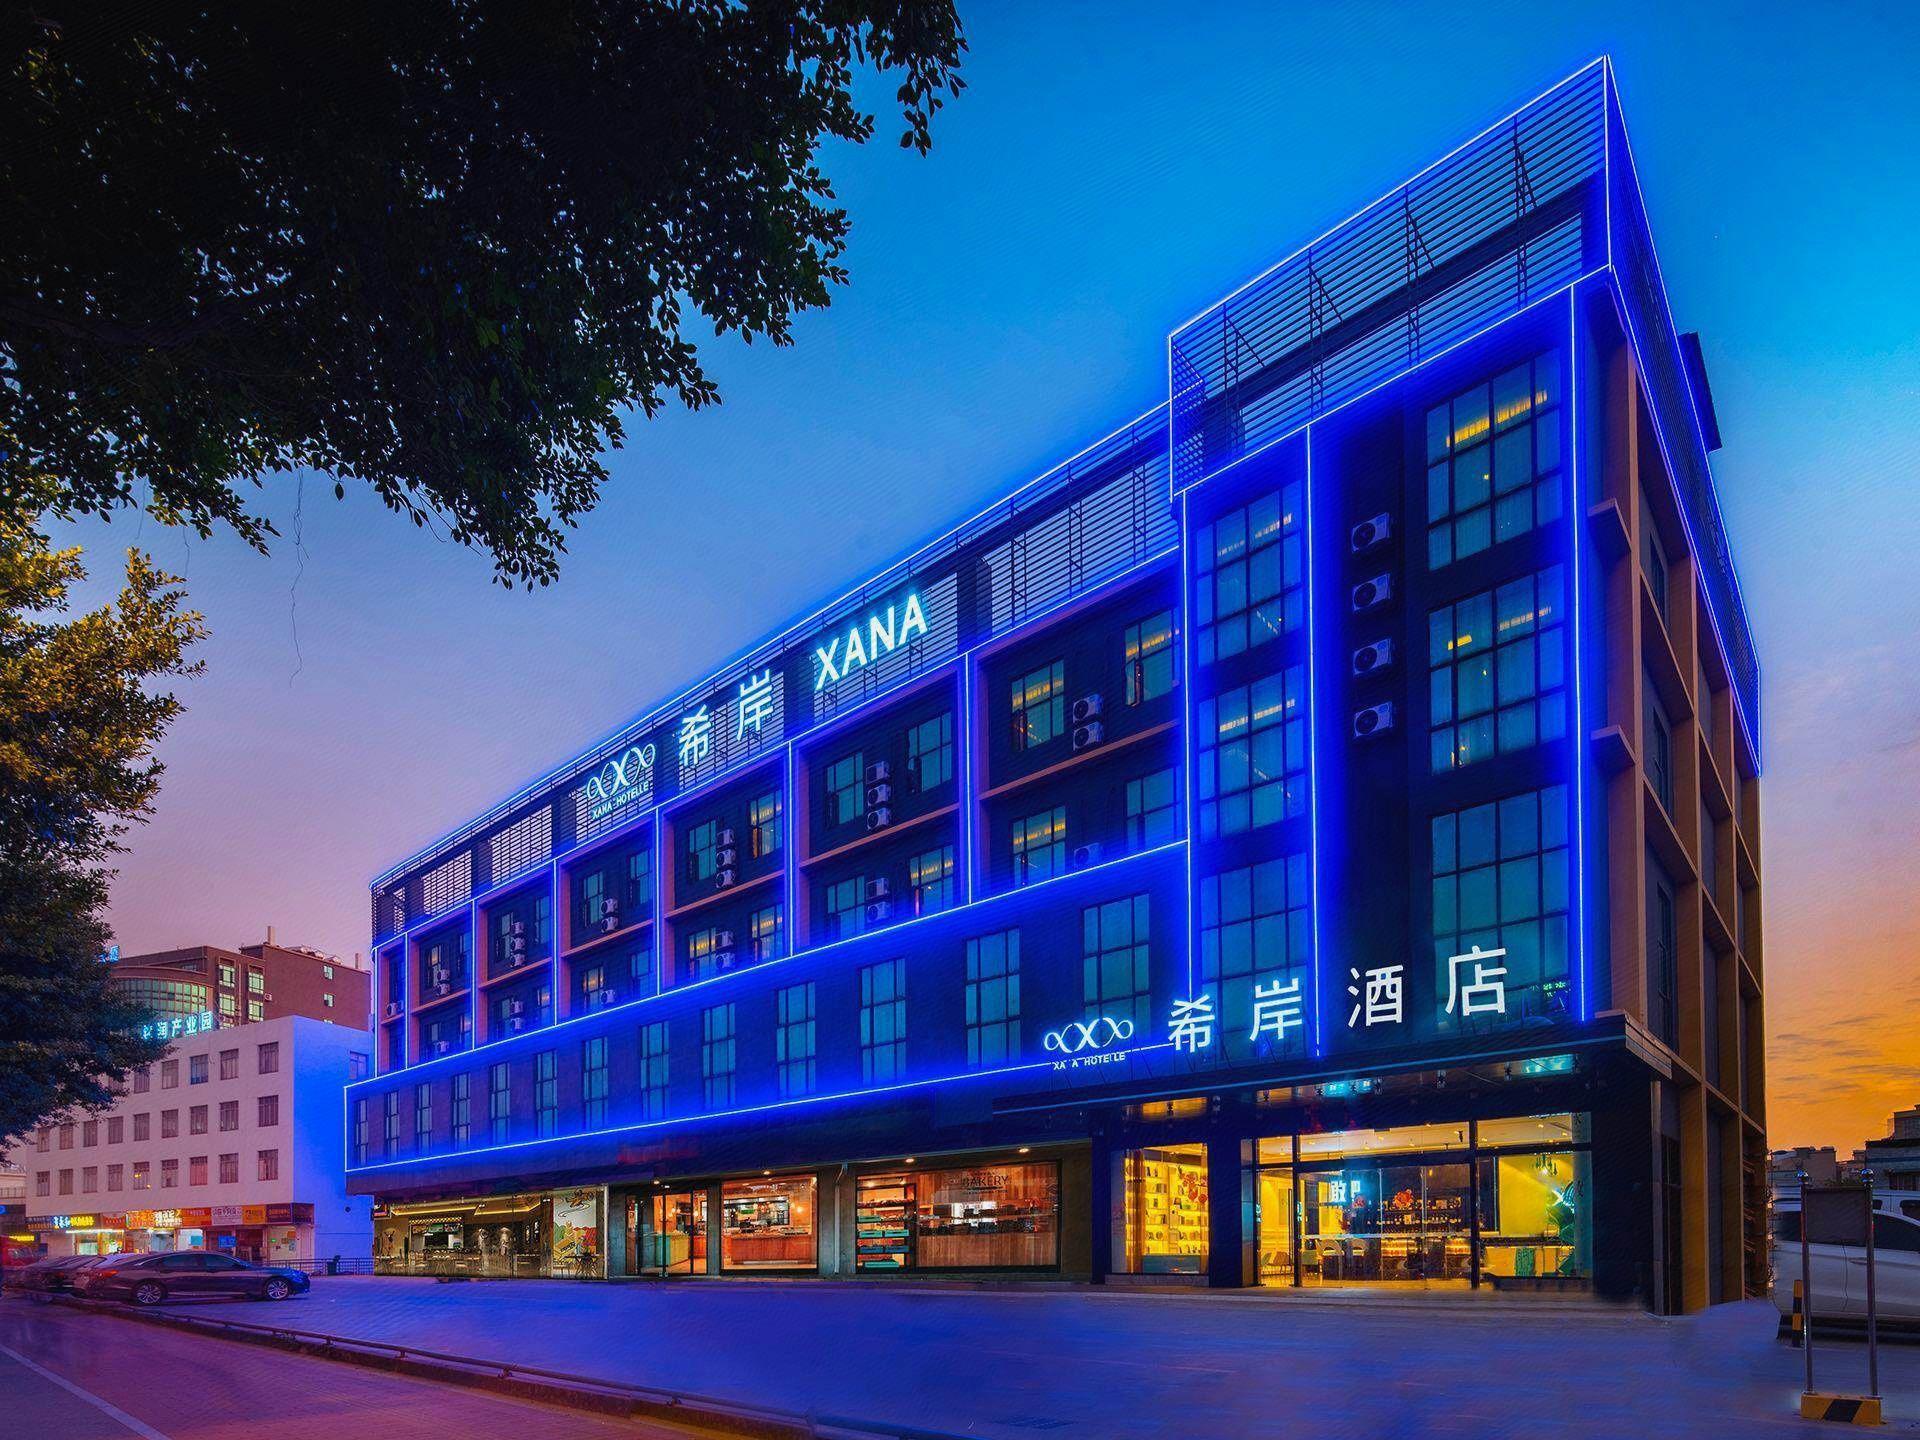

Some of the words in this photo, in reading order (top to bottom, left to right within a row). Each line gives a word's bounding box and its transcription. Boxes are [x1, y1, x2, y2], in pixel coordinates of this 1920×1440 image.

[814, 592, 930, 692] XANA
[678, 668, 775, 768] 希岸
[592, 802, 613, 820] XANA
[616, 780, 650, 807] HOTELLE
[1167, 945, 1507, 1053] 希岸酒店
[1053, 1060, 1079, 1071] XAA
[962, 1175, 1009, 1187] BAKERY
